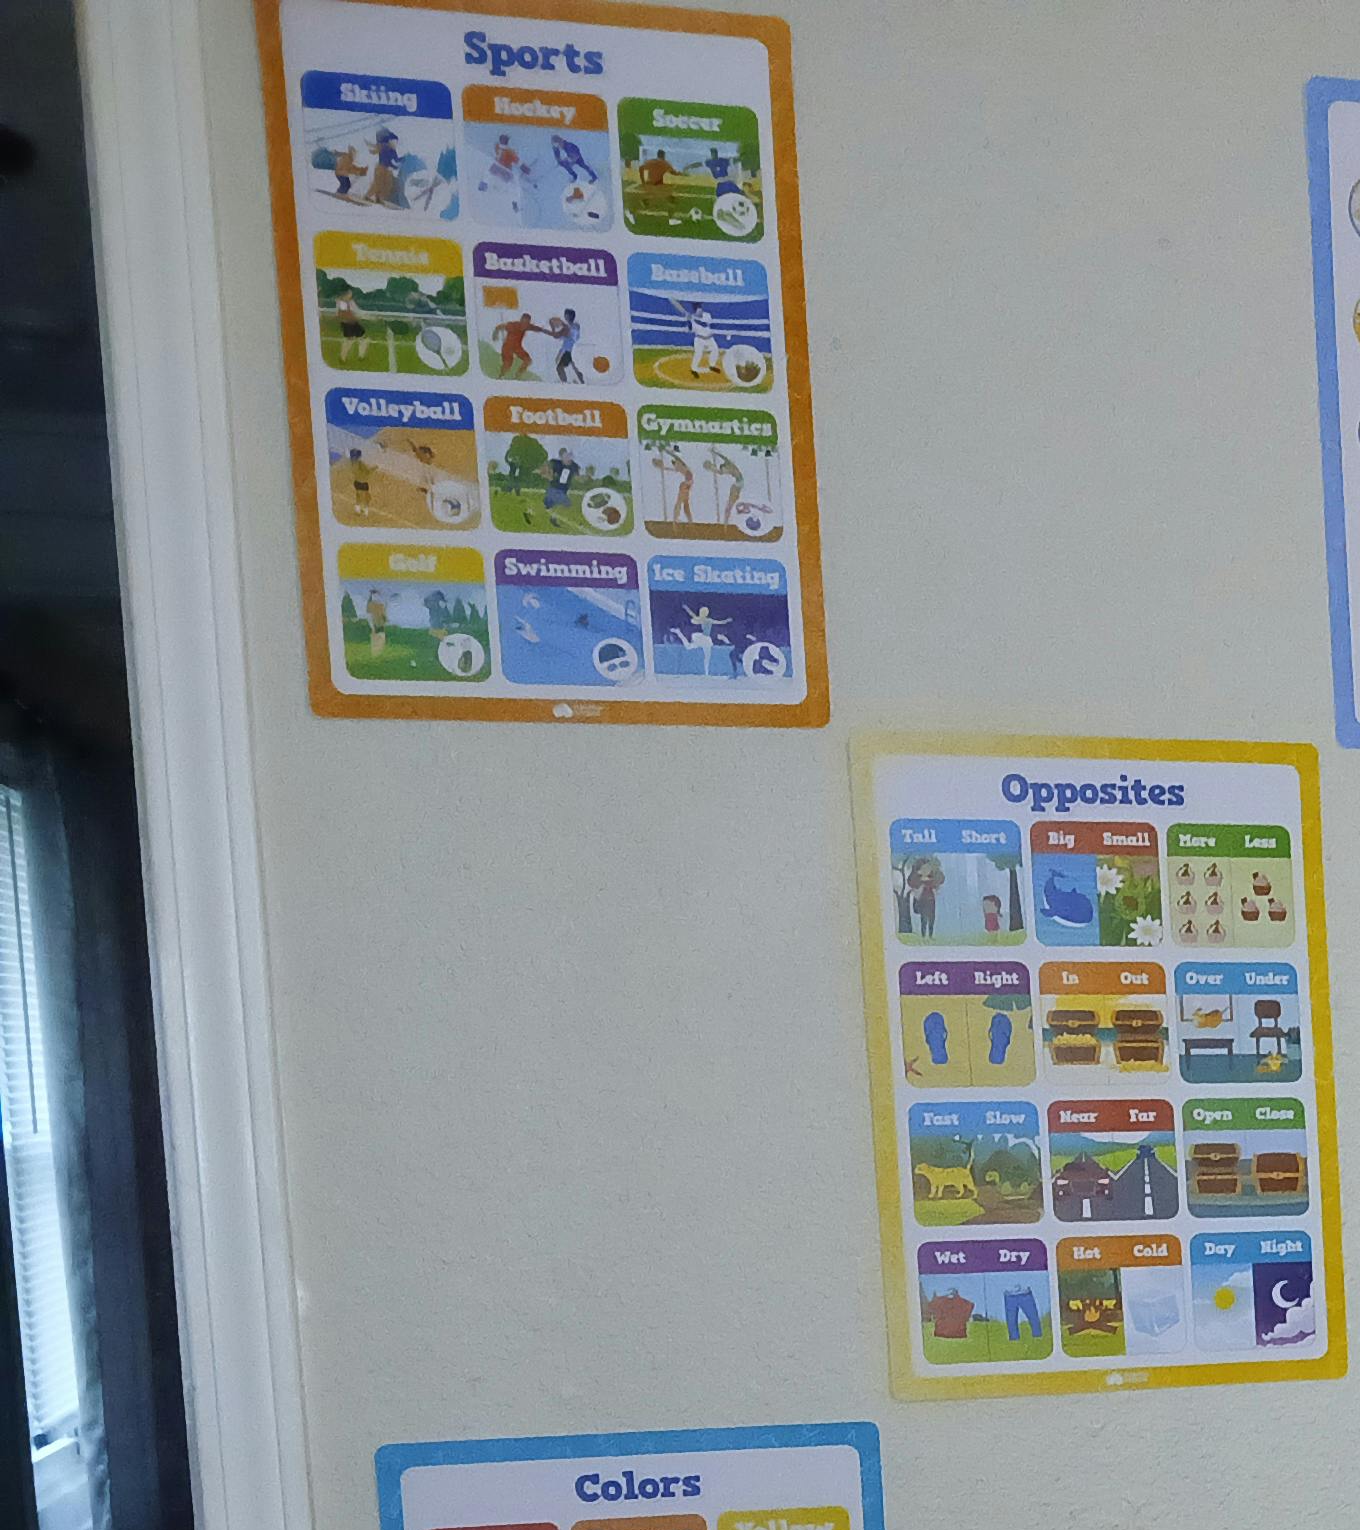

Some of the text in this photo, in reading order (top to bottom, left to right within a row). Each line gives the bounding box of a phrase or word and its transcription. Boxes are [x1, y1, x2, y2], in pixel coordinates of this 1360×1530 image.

[463, 30, 604, 76] Sports
[339, 83, 417, 113] Skiing
[494, 96, 576, 125] Hockey
[652, 109, 723, 133] Soccer
[483, 252, 608, 278] Basketball
[651, 264, 744, 287] Baseball
[341, 397, 462, 421] Volleyball
[510, 406, 602, 429] Football
[640, 413, 773, 438] Gymnastics
[504, 558, 628, 583] Swimming
[653, 563, 780, 590] Ice Skating
[1001, 773, 1185, 813] Opposites
[901, 829, 1007, 845] Tall Short
[1048, 832, 1150, 849] Big Small
[1178, 834, 1276, 849] More Less
[916, 971, 1020, 989] Left Right
[1061, 971, 1149, 986] In Out
[1185, 971, 1289, 987] Over Under
[923, 1110, 1025, 1126] Fast Slow
[1059, 1109, 1156, 1124] Near Far
[1193, 1107, 1294, 1124] Open Close
[934, 1249, 1030, 1266] Wet Dry
[1072, 1243, 1168, 1261] Hot Cold
[1204, 1239, 1303, 1259] Day Night
[575, 1470, 701, 1503] Colors
